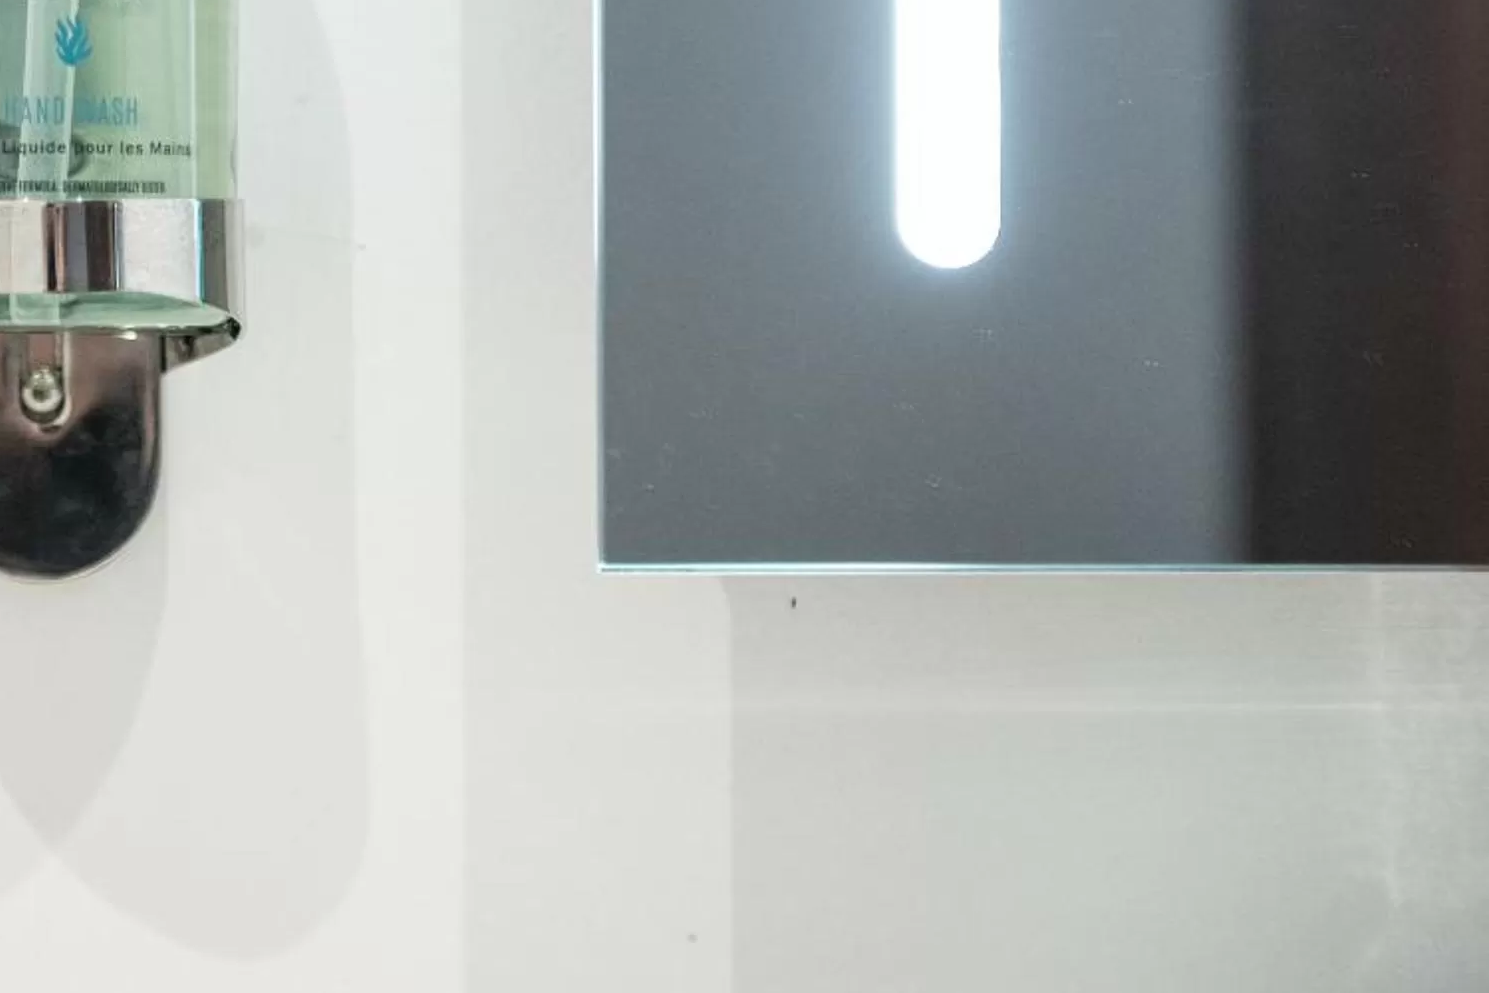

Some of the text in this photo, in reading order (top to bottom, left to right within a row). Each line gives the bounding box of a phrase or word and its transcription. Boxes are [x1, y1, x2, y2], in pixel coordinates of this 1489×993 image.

[74, 95, 137, 126] ASH
[1, 139, 67, 156] Liquide
[74, 143, 113, 157] pour
[120, 140, 143, 156] les
[150, 141, 192, 157] Mains
